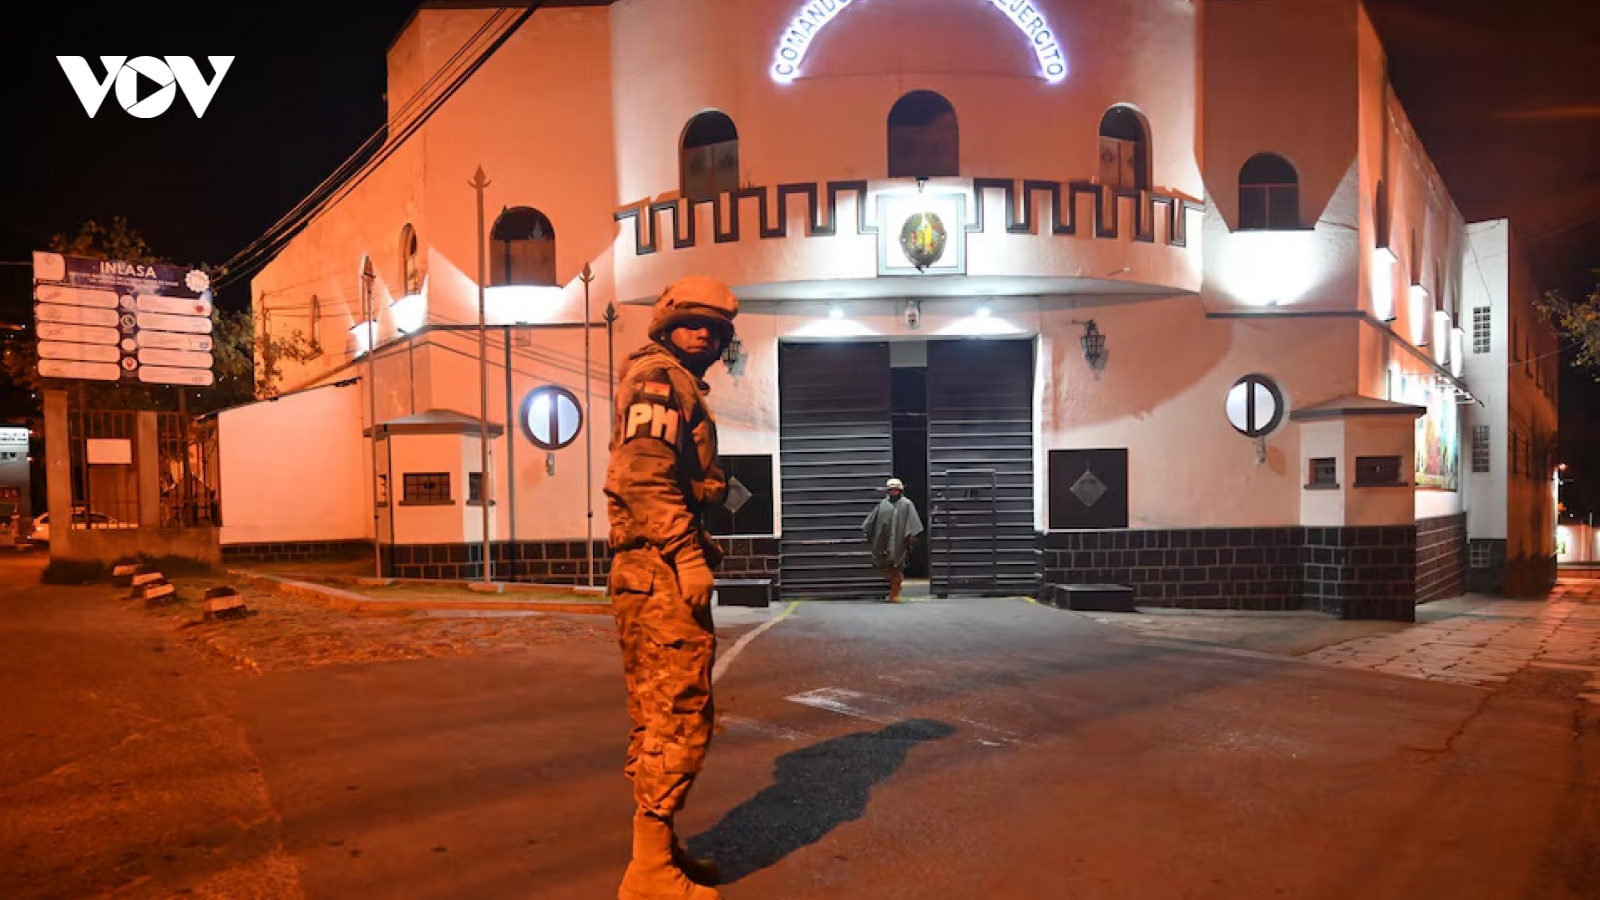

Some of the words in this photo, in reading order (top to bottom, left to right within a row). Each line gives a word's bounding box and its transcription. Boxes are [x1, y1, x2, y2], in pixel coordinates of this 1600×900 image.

[775, 0, 848, 76] COMAND
[998, 0, 1063, 76] JERCITO
[99, 261, 157, 279] INLASA
[626, 403, 679, 444] PM
